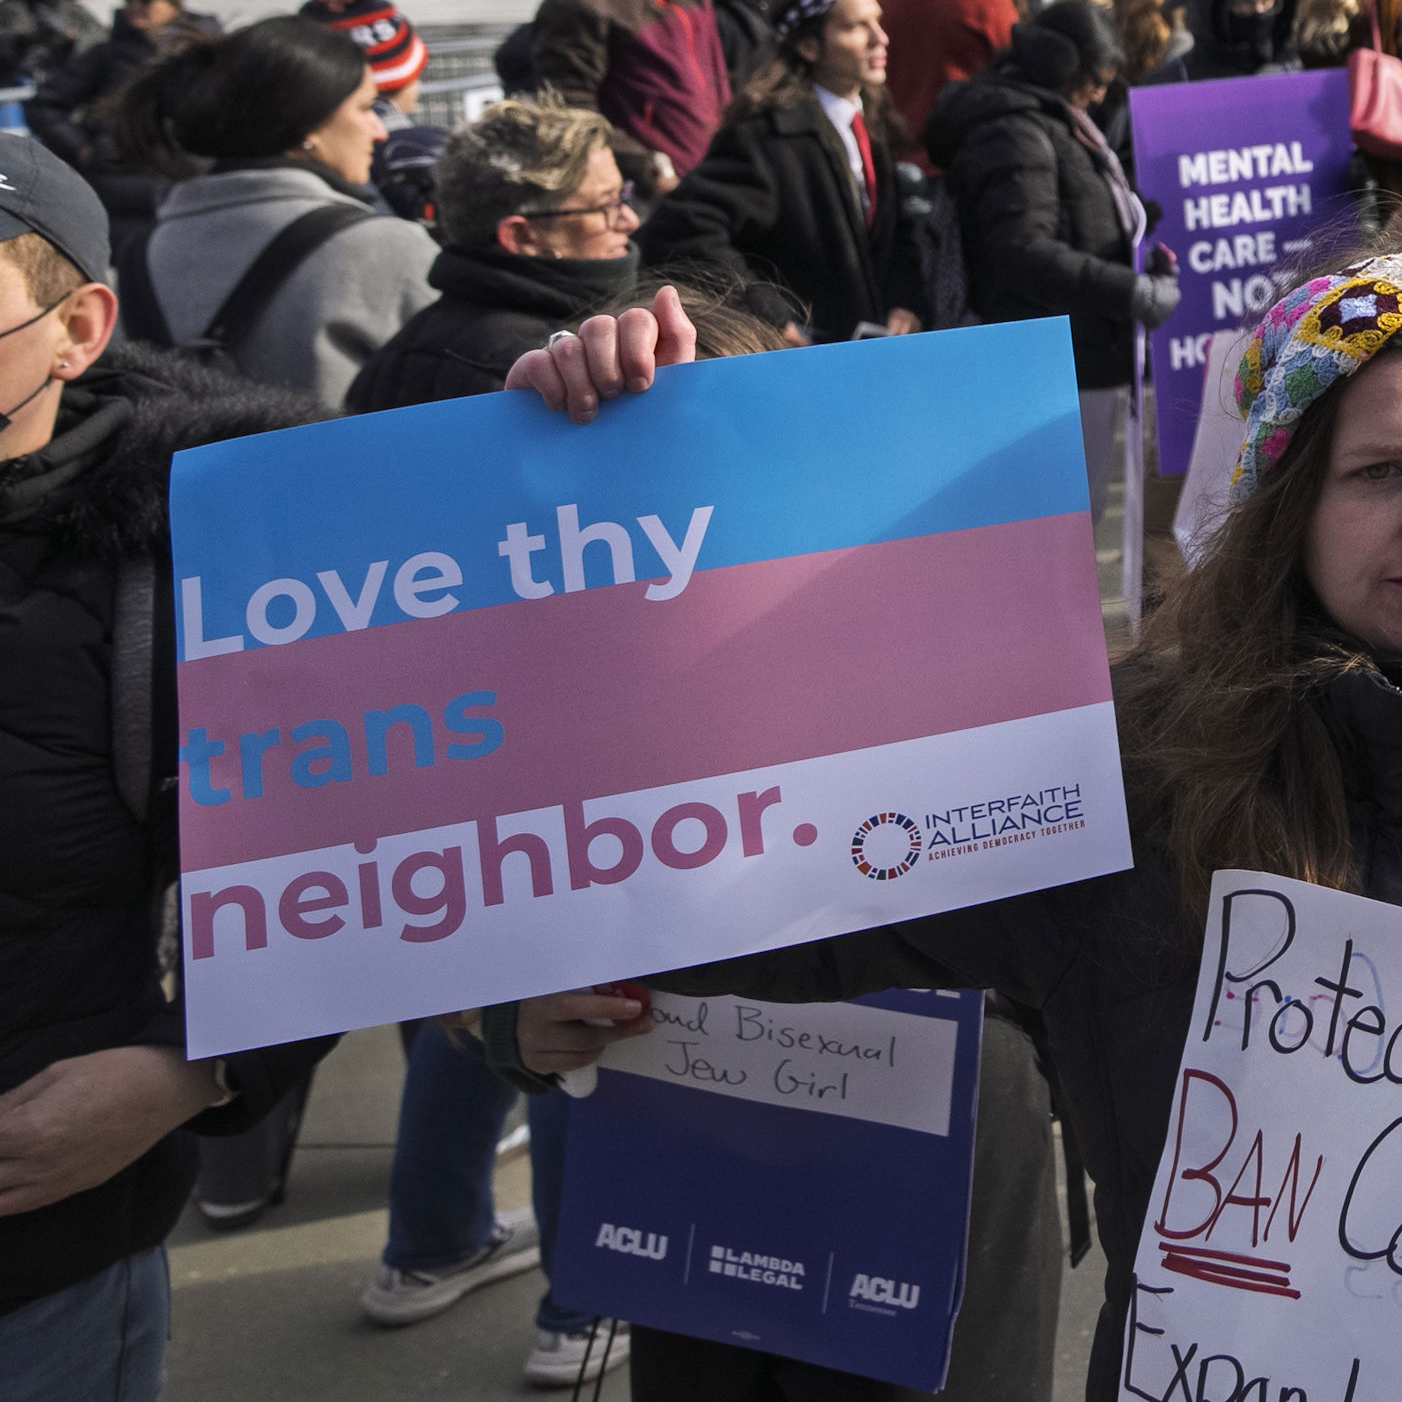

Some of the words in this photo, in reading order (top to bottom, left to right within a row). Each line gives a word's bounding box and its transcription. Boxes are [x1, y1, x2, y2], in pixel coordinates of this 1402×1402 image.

[1177, 140, 1314, 188] MENTAL
[1183, 183, 1313, 231] HEALTH
[1188, 231, 1278, 273] CARE
[181, 551, 463, 663] Love
[498, 503, 714, 602] thy
[179, 690, 505, 807] trans
[925, 783, 1081, 829] INTERFAITH
[927, 799, 1084, 850] ALLIANCE
[928, 842, 979, 862] ACHIEVING
[982, 831, 1037, 850] DEMOCRACY
[1040, 819, 1086, 837] TOGETHER
[189, 784, 818, 961] neighbor.
[650, 1002, 709, 1036] oud
[734, 1004, 896, 1068] Bisexual
[666, 1039, 747, 1086] Jew
[773, 1058, 849, 1100] Girl
[1154, 1068, 1325, 1247] BAN
[595, 1222, 669, 1261] ACLU
[724, 1247, 806, 1277] LAMBDA
[736, 1264, 804, 1291] LEGAL
[849, 1273, 921, 1310] ACLU
